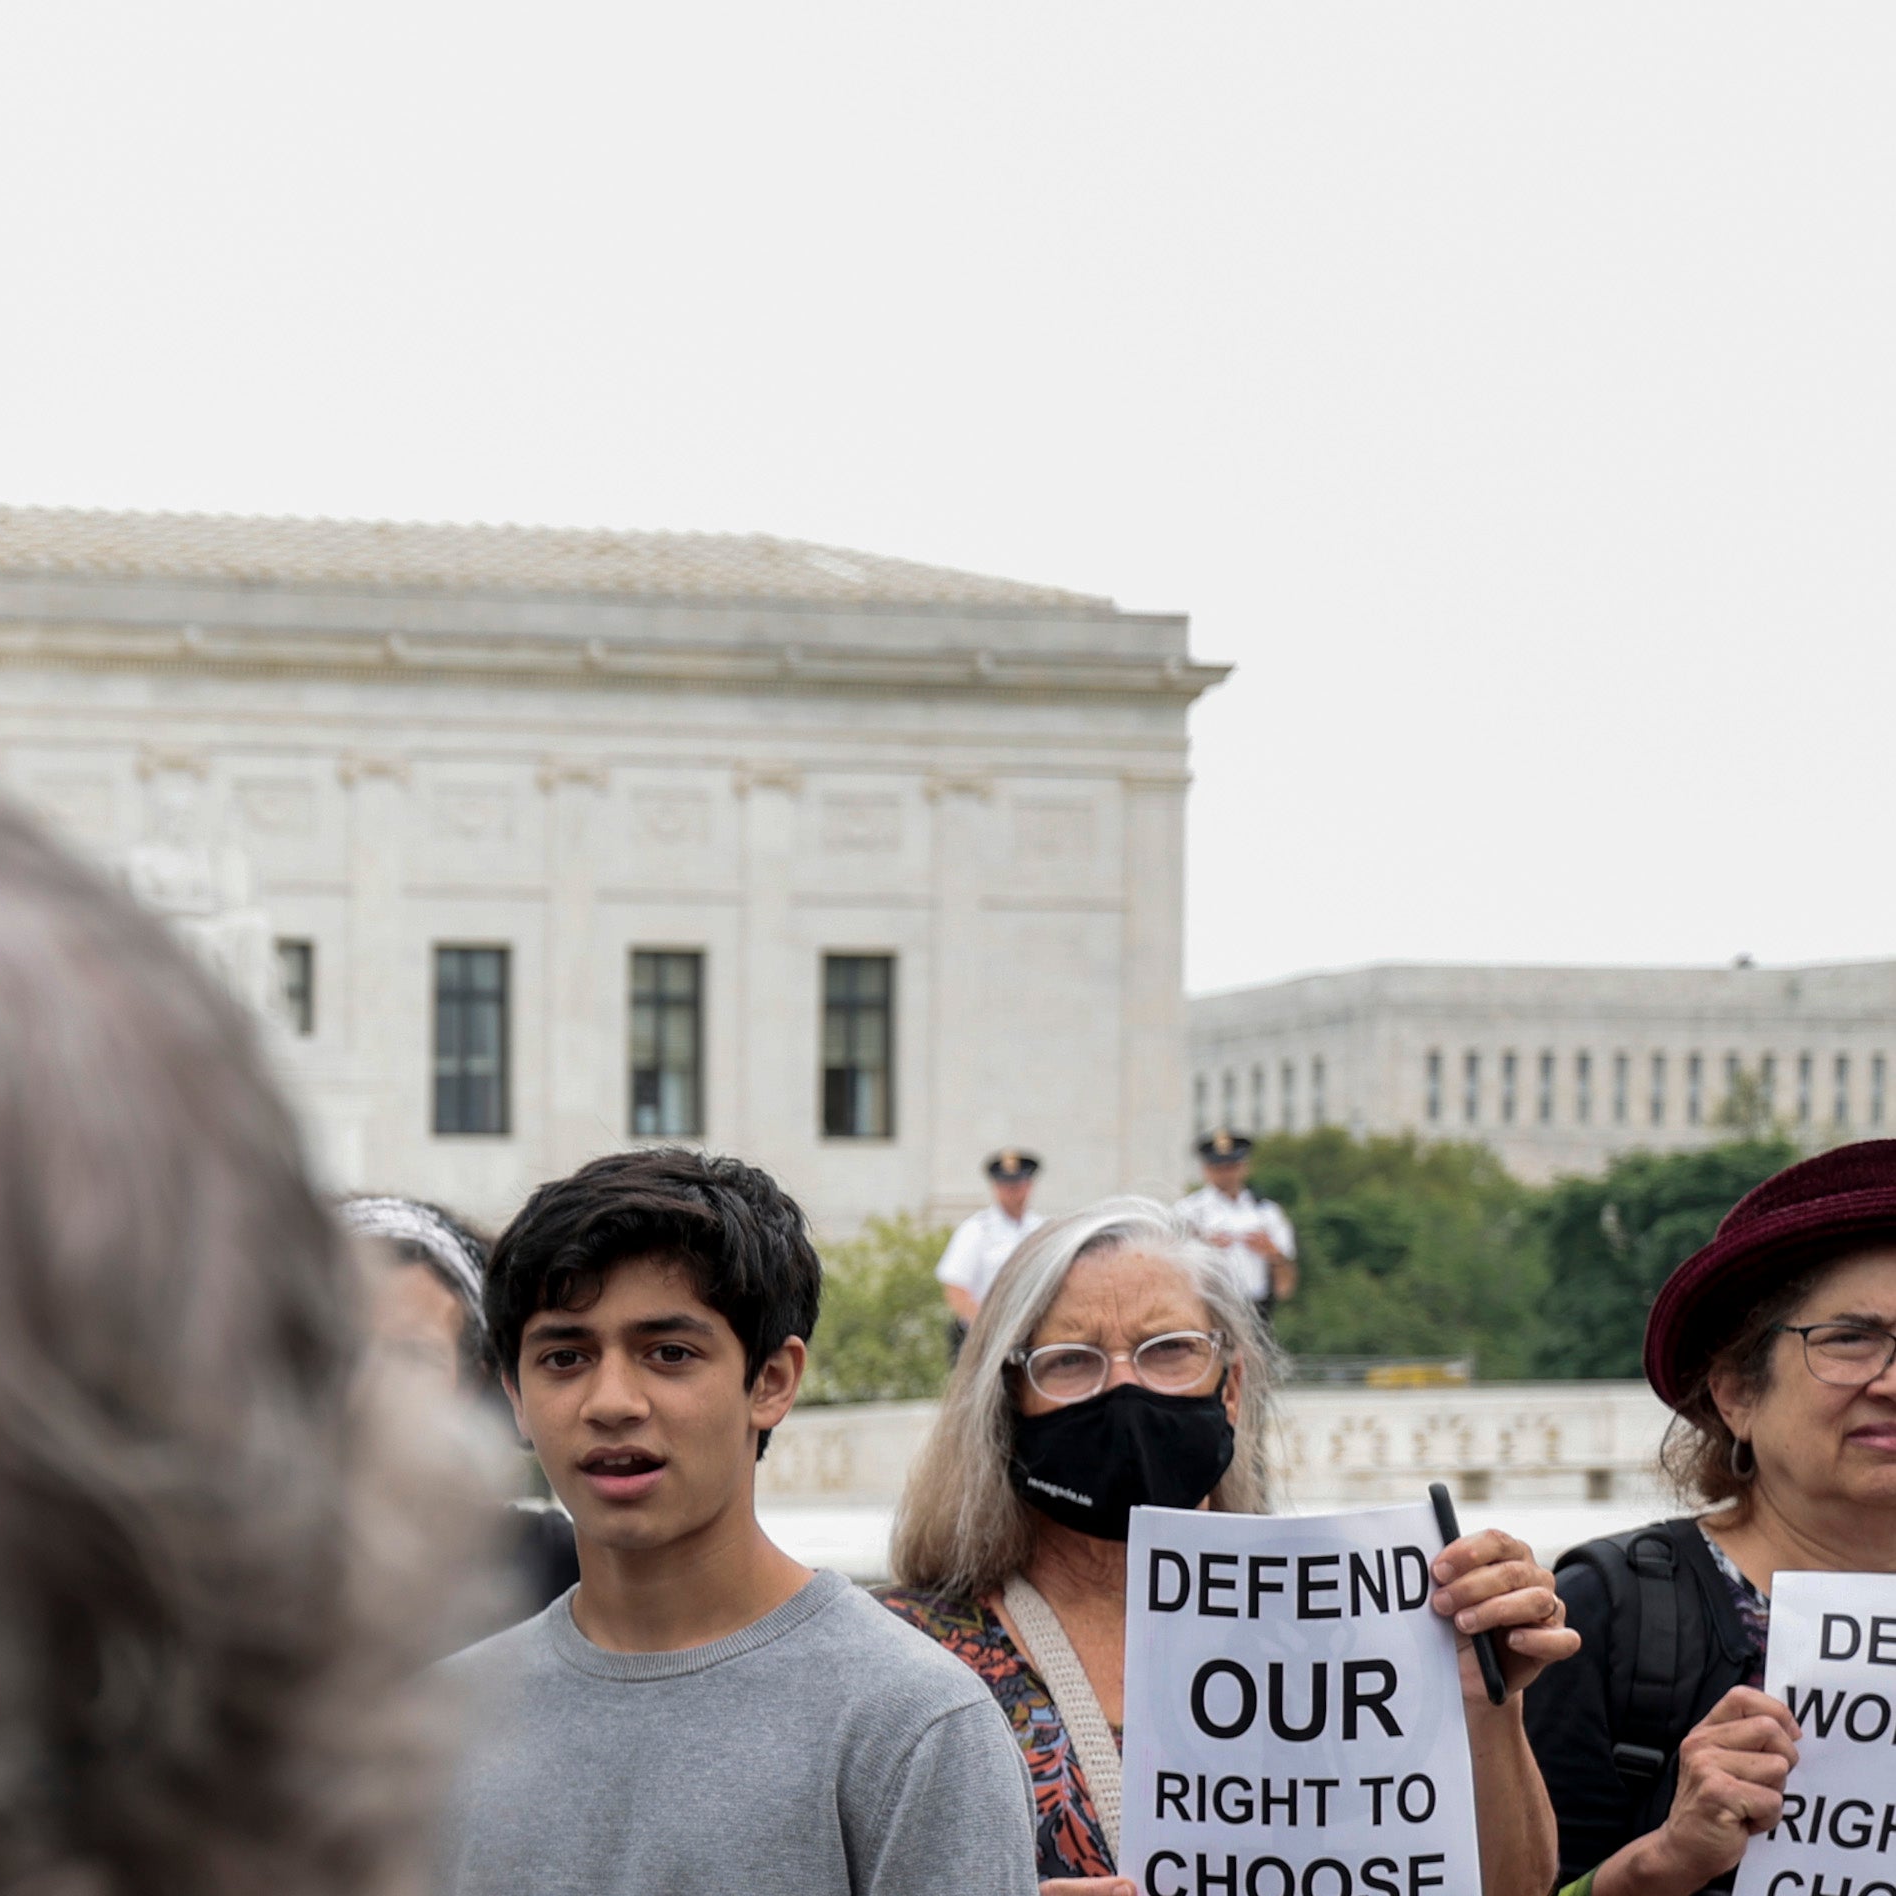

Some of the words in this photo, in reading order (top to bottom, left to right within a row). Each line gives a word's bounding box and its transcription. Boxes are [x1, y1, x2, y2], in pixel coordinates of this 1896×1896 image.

[1148, 1545, 1430, 1621] DEFEND
[1190, 1658, 1403, 1742] OUR
[1785, 1685, 1896, 1745] WO
[1155, 1770, 1339, 1828] RIGHT
[1361, 1772, 1437, 1826] TO
